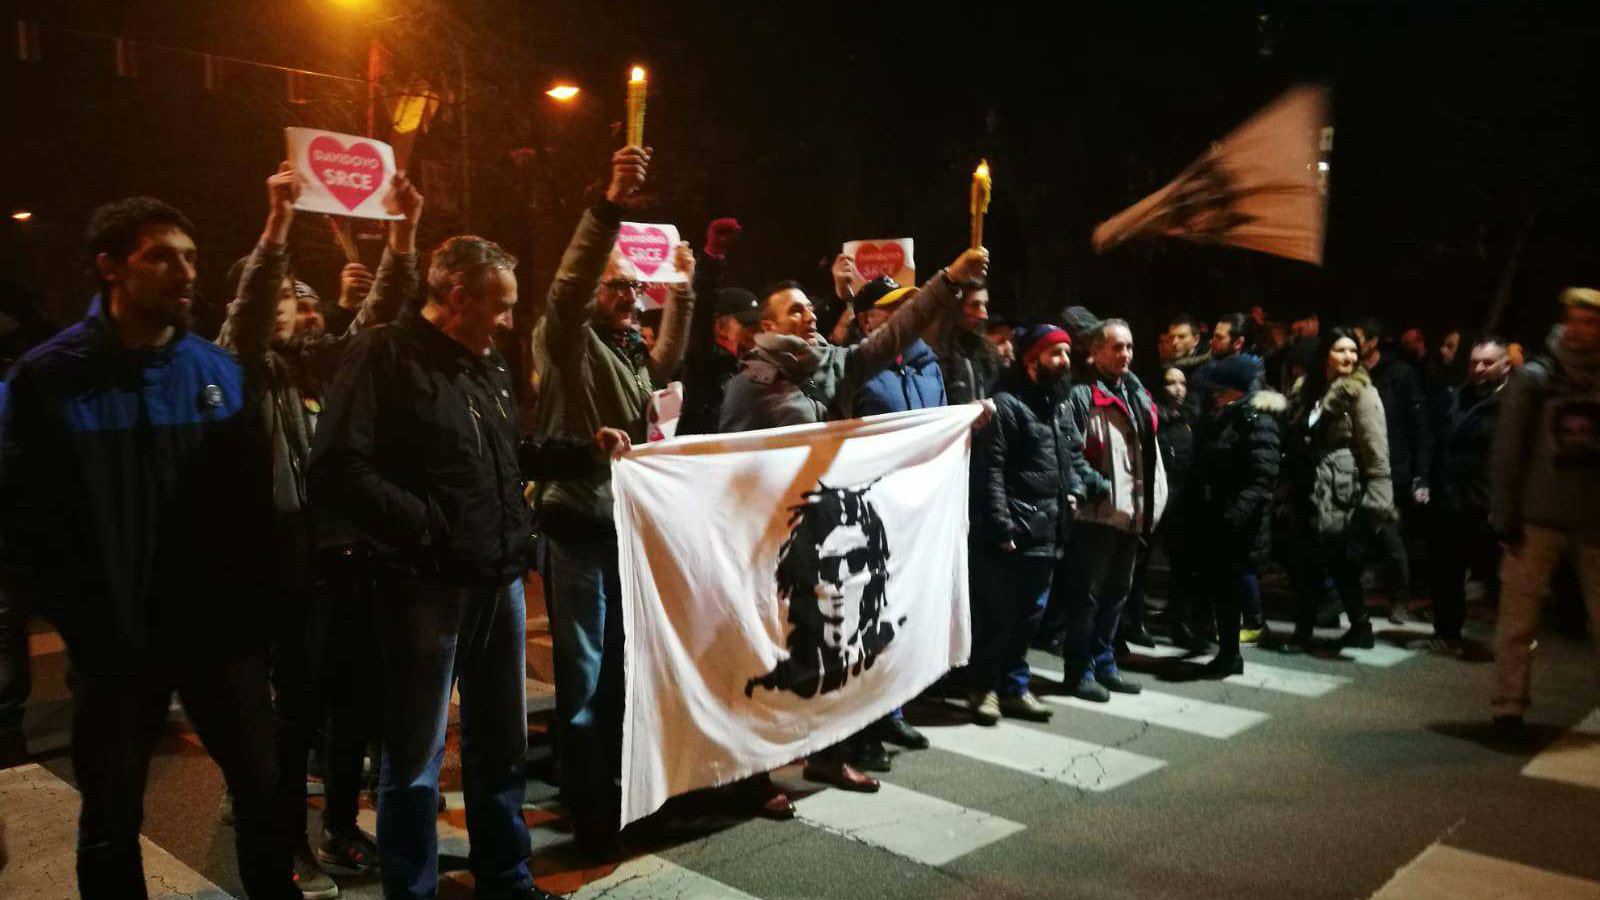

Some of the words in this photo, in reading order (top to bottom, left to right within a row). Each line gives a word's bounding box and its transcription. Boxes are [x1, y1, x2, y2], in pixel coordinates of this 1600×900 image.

[313, 149, 379, 168] DAVIDOVO
[323, 169, 373, 190] SRCE
[630, 247, 663, 262] SRCE
